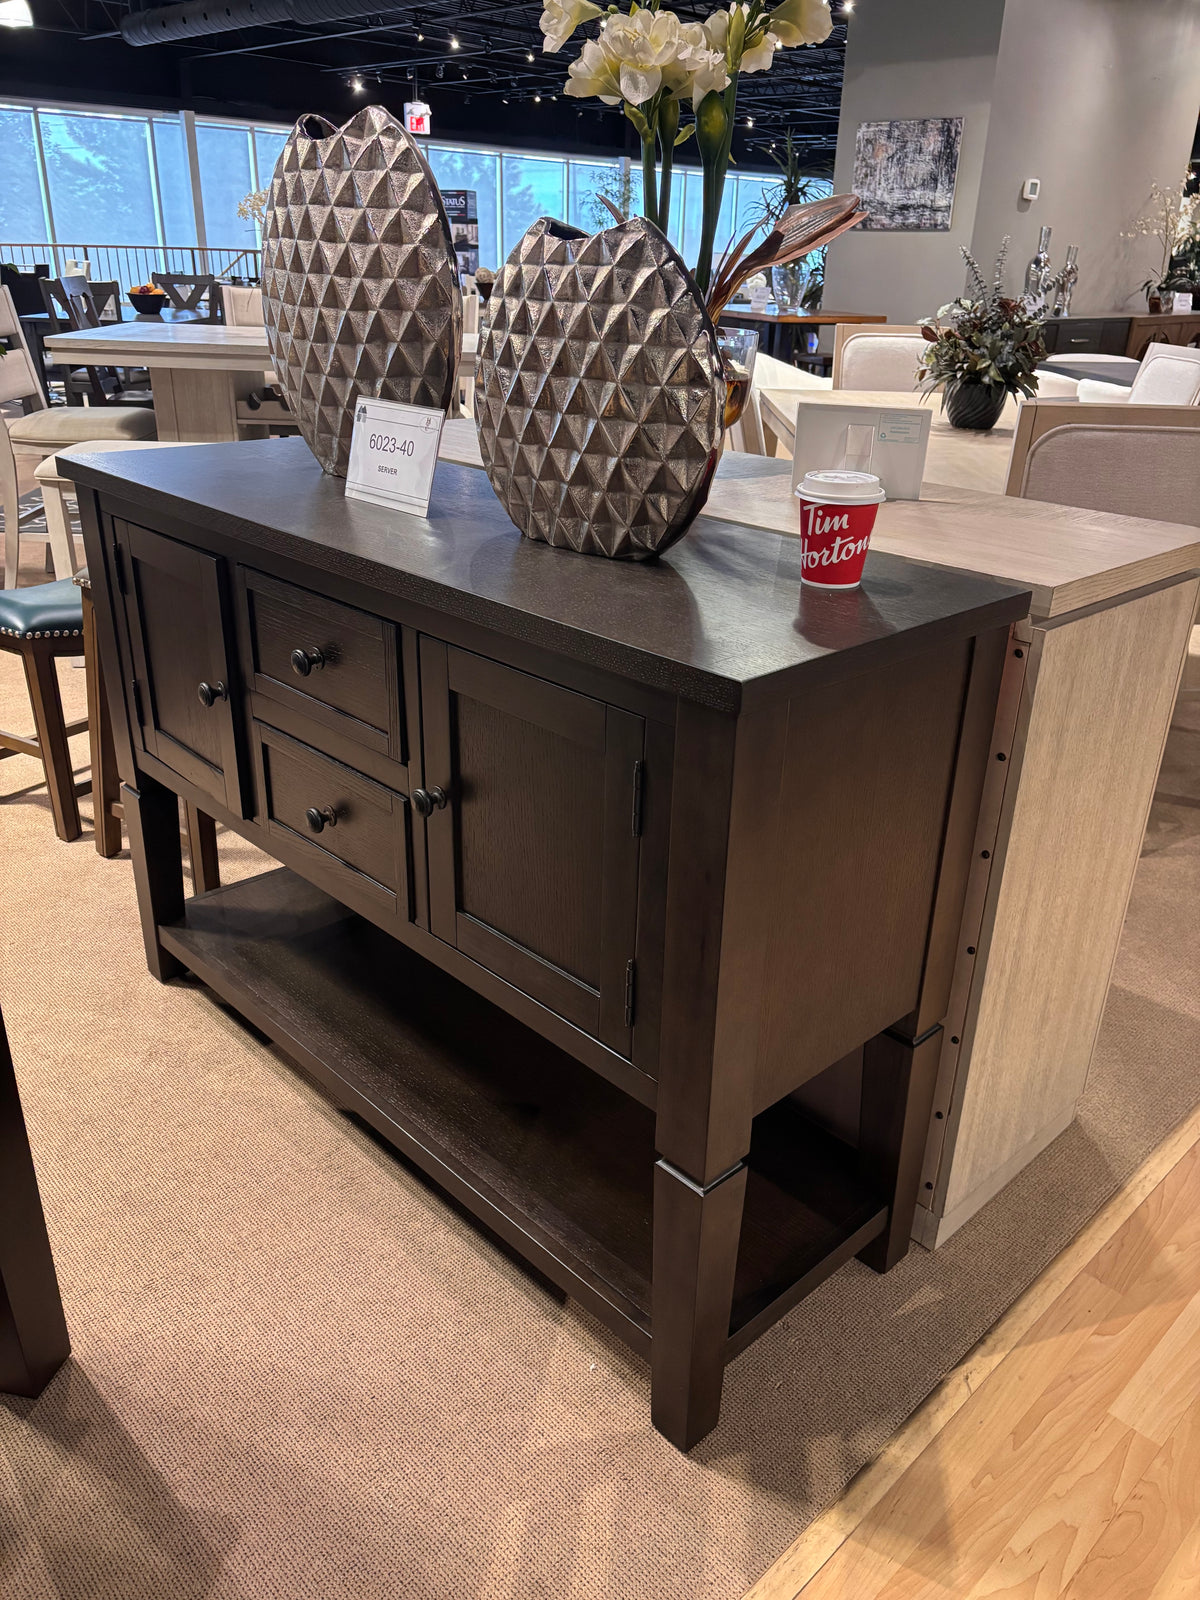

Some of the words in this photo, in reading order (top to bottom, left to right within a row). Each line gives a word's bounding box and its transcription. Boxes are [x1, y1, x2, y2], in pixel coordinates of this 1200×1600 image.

[369, 433, 415, 457] 6023-40
[377, 465, 398, 475] SERVER
[803, 504, 849, 536] Tim
[801, 535, 871, 570] Horton
